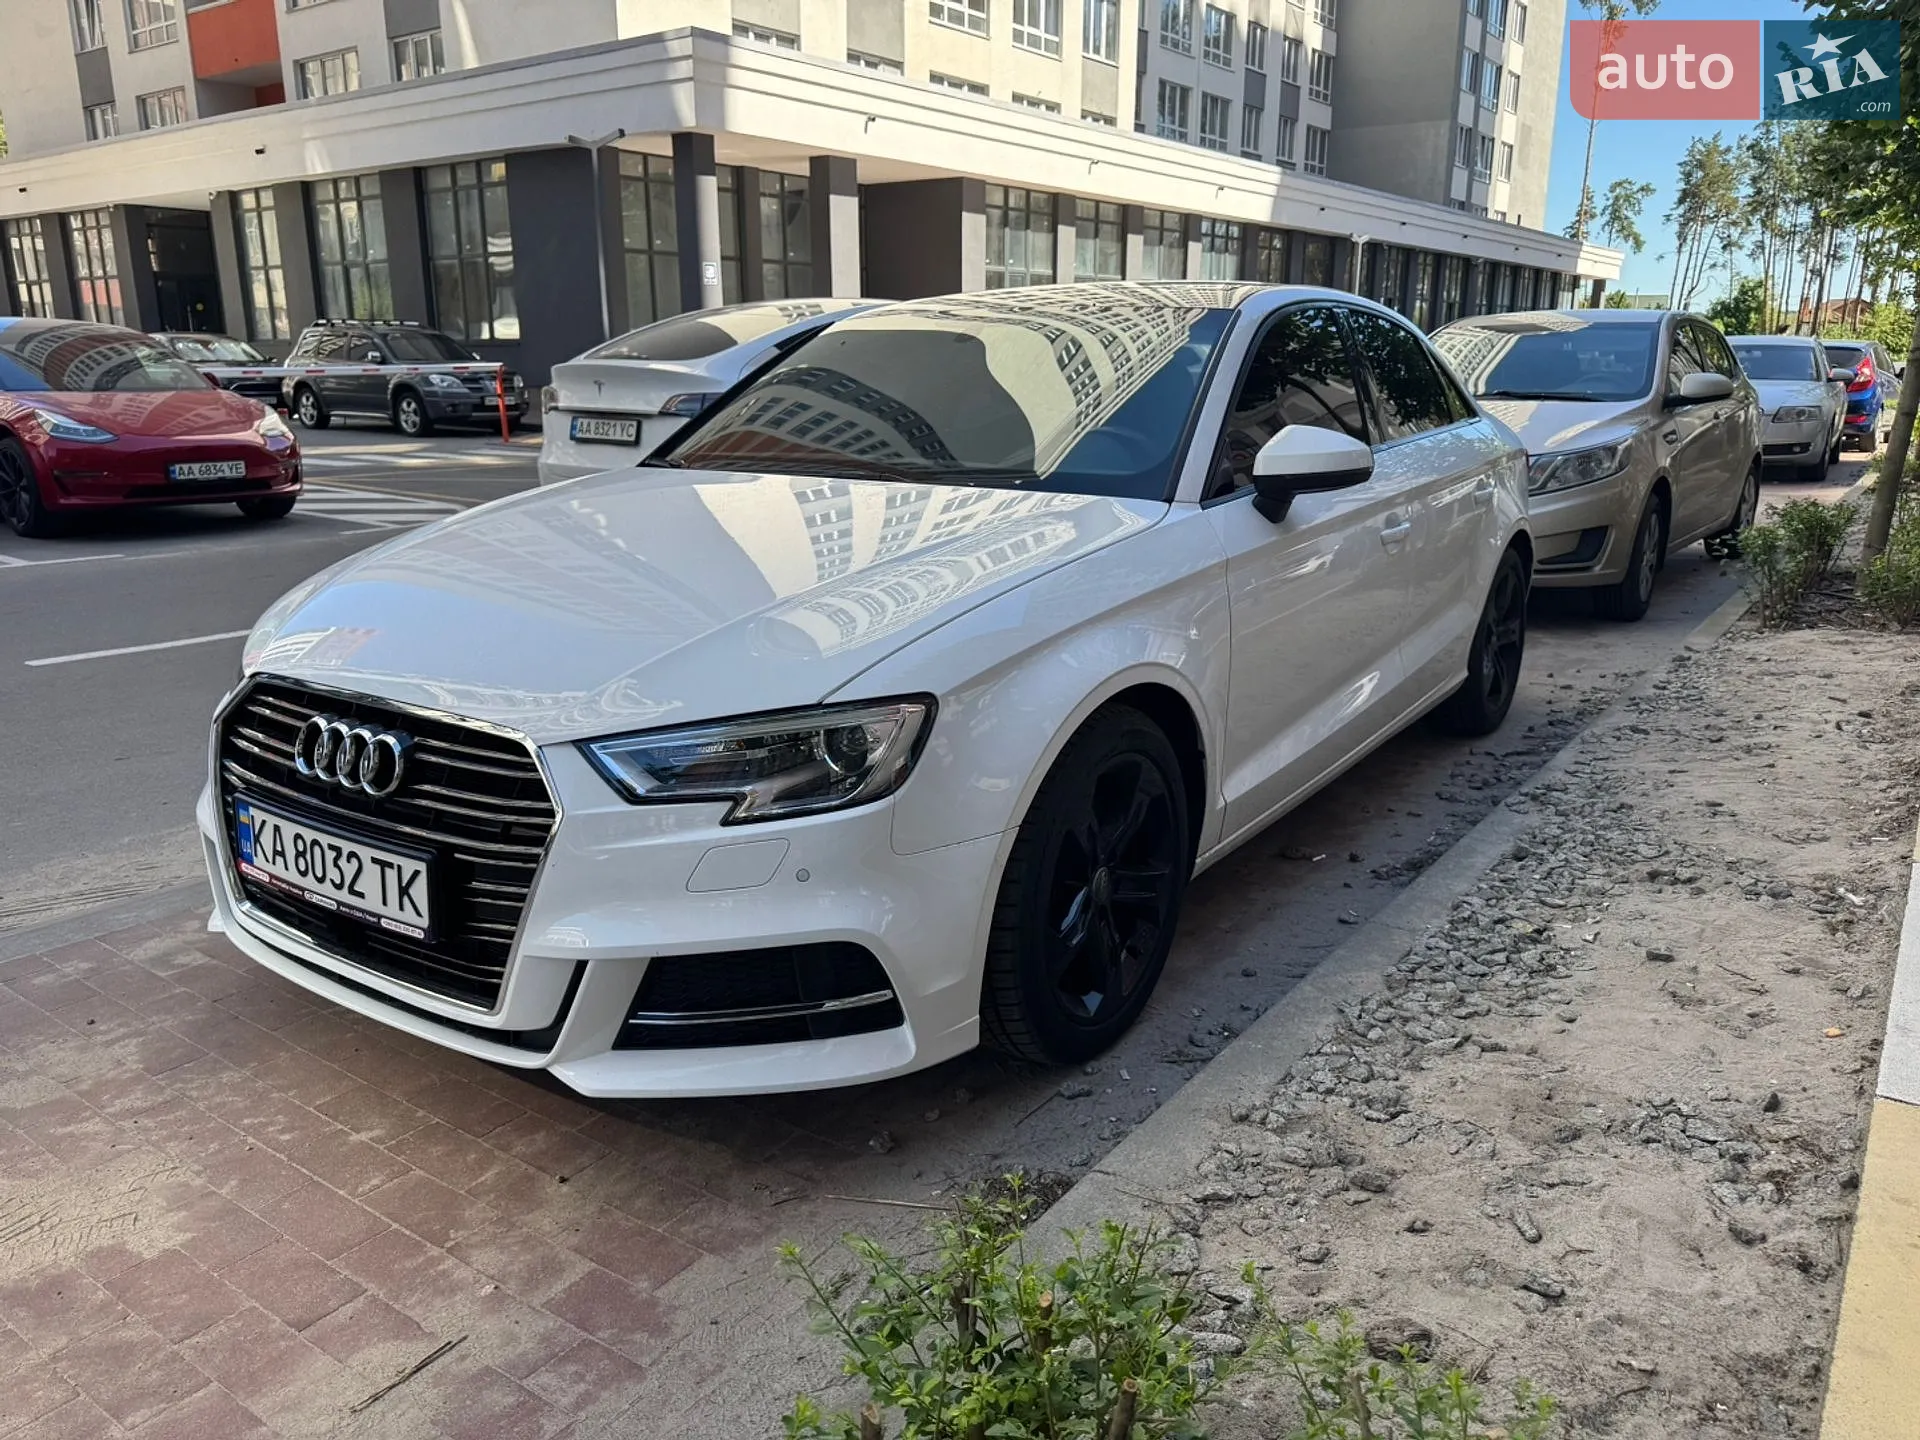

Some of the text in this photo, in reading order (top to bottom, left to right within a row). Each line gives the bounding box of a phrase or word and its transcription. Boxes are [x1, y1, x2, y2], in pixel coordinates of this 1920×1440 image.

[577, 421, 635, 438] AA 8321 YC
[178, 462, 243, 477] AA 6834 YE
[250, 814, 424, 919] KA 8032 TK
